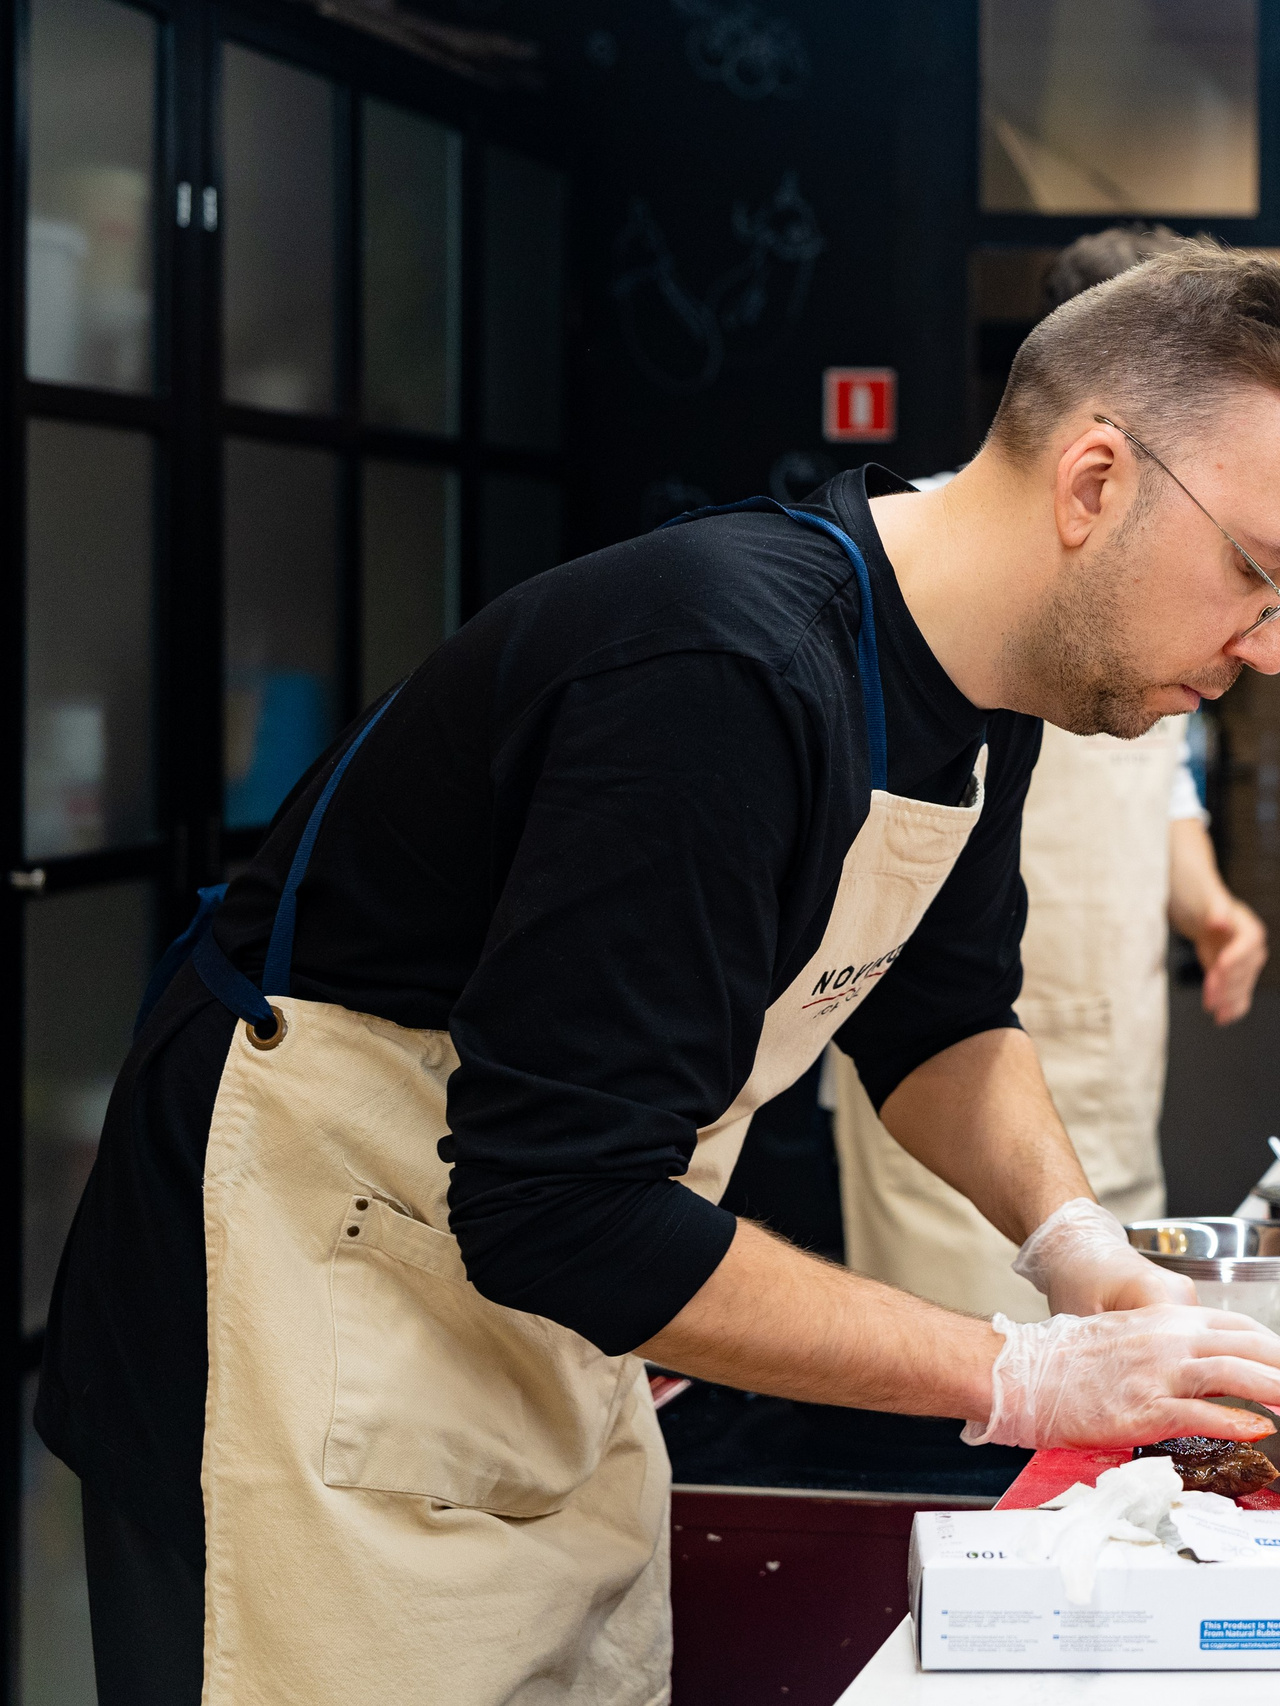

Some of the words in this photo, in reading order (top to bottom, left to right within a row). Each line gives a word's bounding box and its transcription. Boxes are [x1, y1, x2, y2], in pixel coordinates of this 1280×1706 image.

[1203, 1621, 1221, 1629] This
[1223, 1621, 1255, 1629] Product
[1203, 1629, 1224, 1637] From
[1225, 1629, 1255, 1637] Natural
